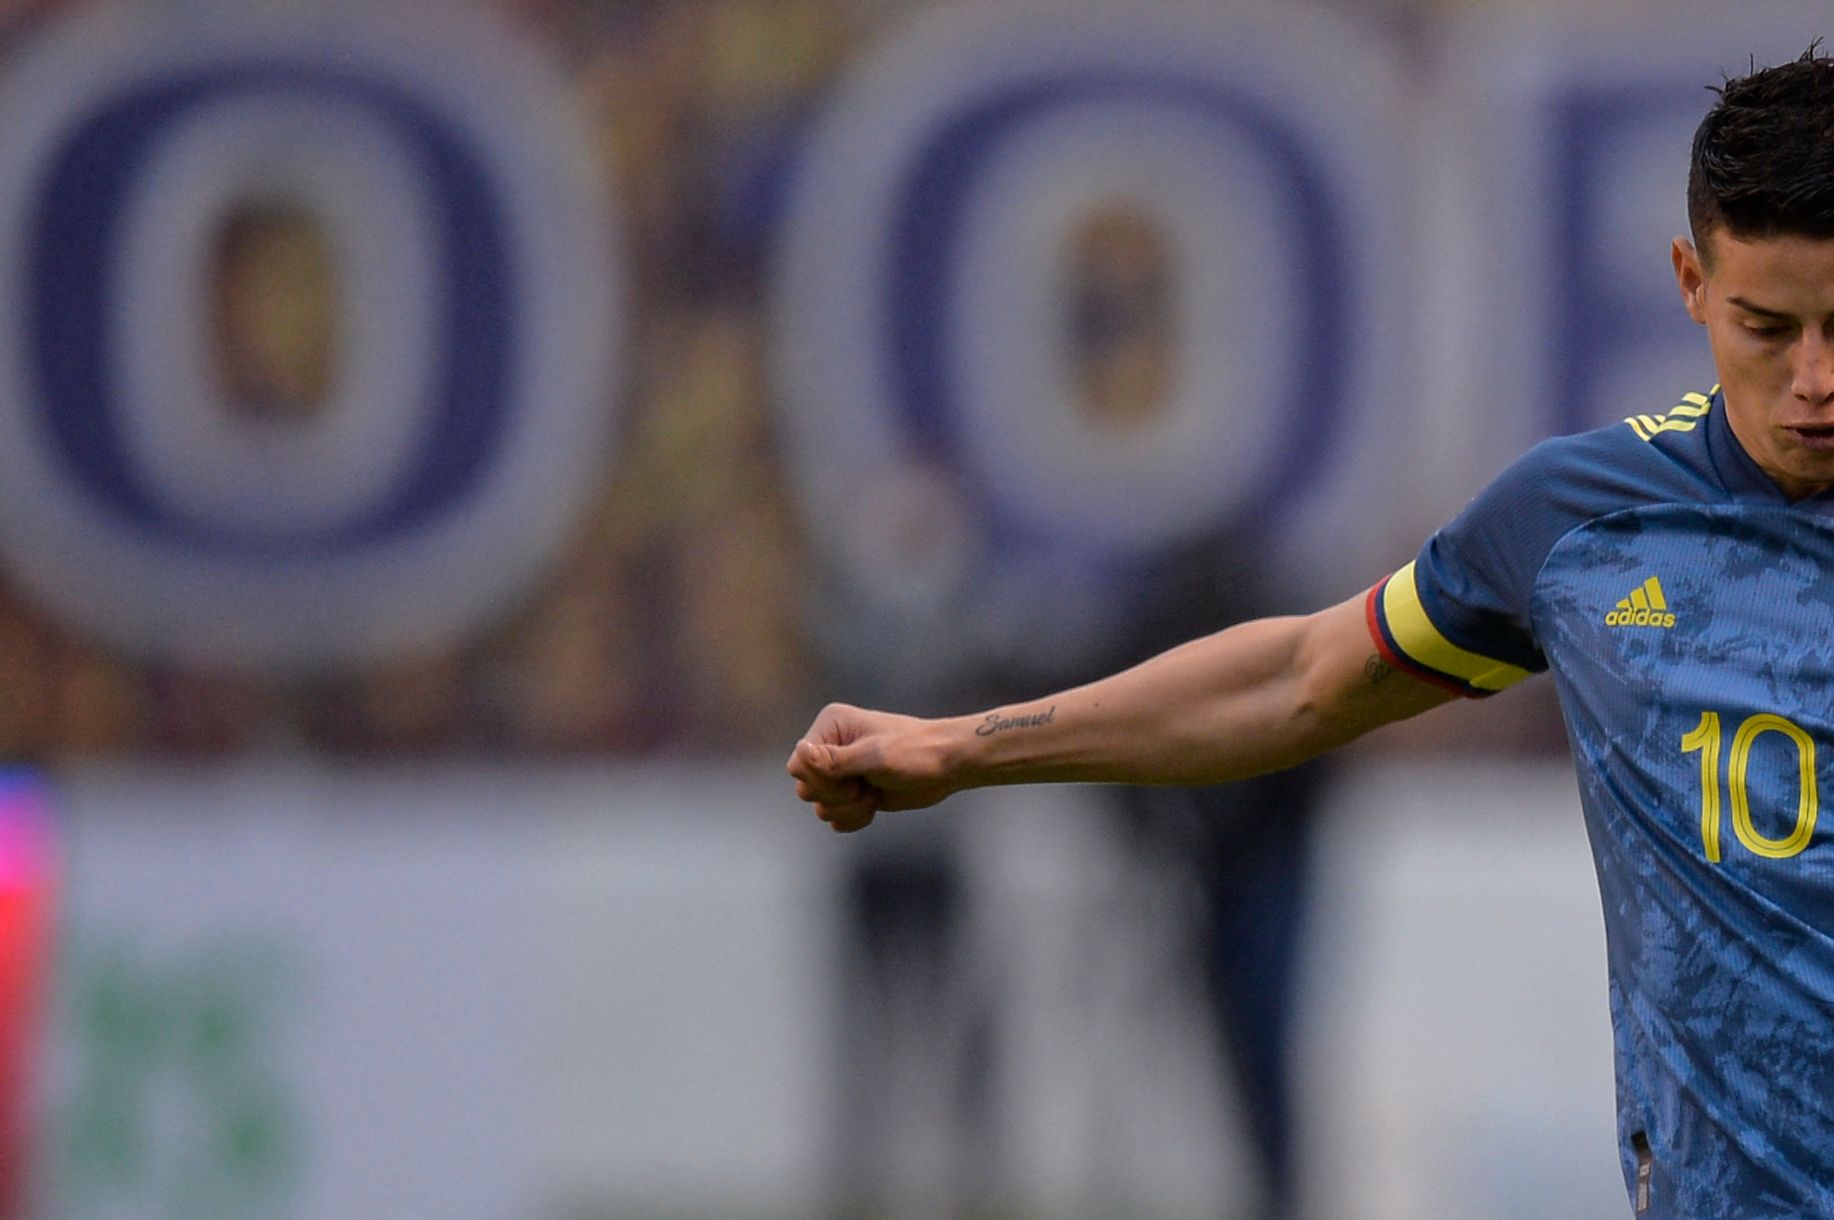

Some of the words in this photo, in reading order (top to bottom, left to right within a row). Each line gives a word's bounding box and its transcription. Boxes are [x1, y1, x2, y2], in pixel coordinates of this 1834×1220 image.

[1605, 607, 1676, 628] adidas
[976, 706, 1056, 736] Samuel
[1681, 711, 1818, 863] 10
